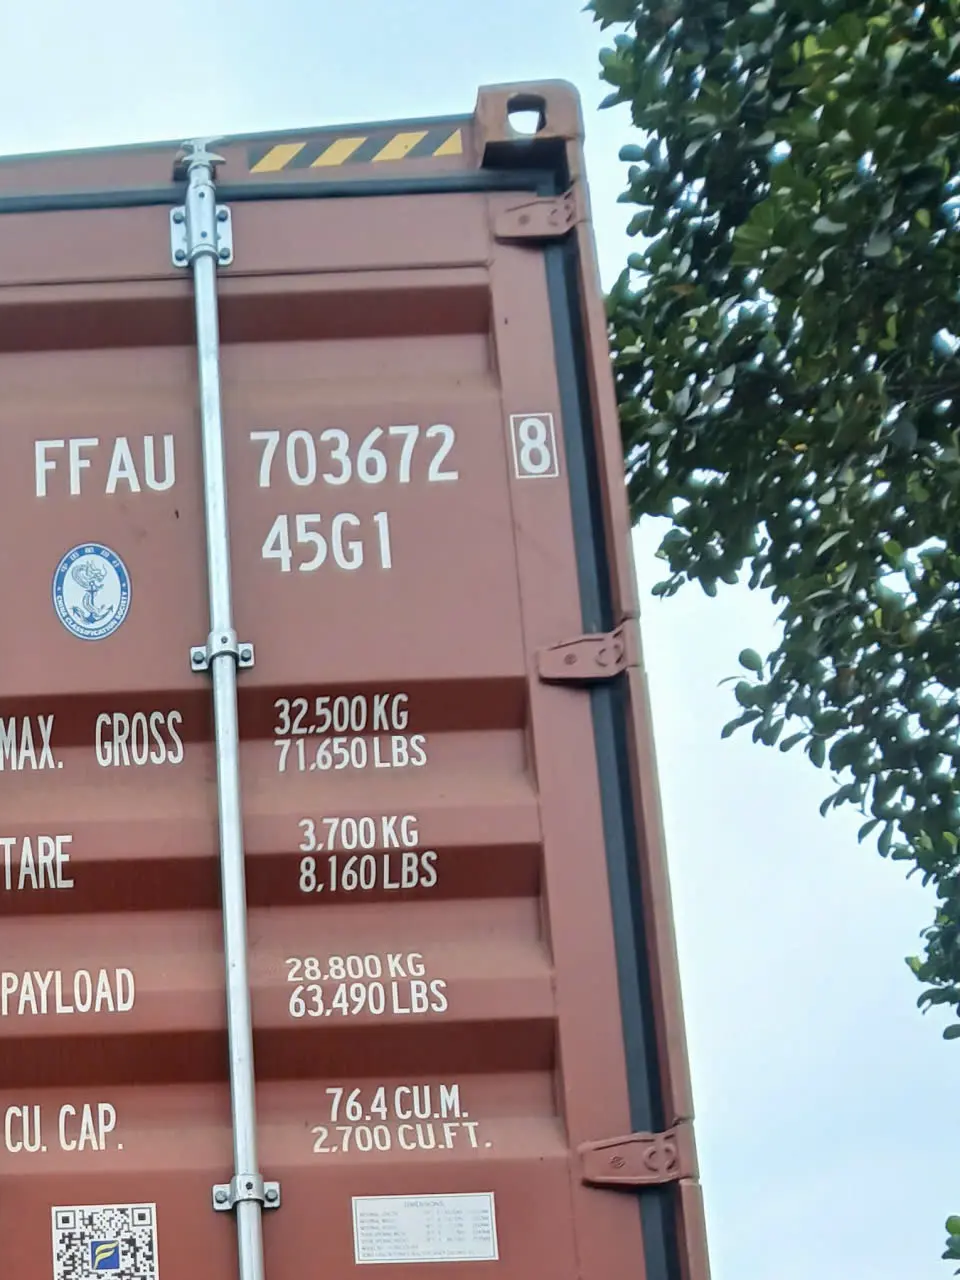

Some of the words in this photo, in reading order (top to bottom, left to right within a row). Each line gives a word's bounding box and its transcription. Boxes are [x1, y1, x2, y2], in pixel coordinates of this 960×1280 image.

[34, 434, 176, 497] FFAU
[249, 424, 459, 488] 703672
[518, 417, 551, 474] 8
[262, 511, 392, 572] 45G1
[372, 693, 409, 731] KG
[96, 711, 184, 768] GROSS
[373, 735, 427, 769] LBS
[383, 815, 420, 849] KG
[0, 834, 74, 890] TARE
[383, 851, 438, 890] LBS
[387, 953, 426, 979] KG
[1, 967, 135, 1016] PAYLOAD
[391, 979, 449, 1014] LBS
[325, 1086, 387, 1122] 76.4
[393, 1084, 470, 1120] CU.M.
[4, 1104, 48, 1154] CU.
[58, 1102, 124, 1152] CAP.
[311, 1126, 392, 1154] 2,700
